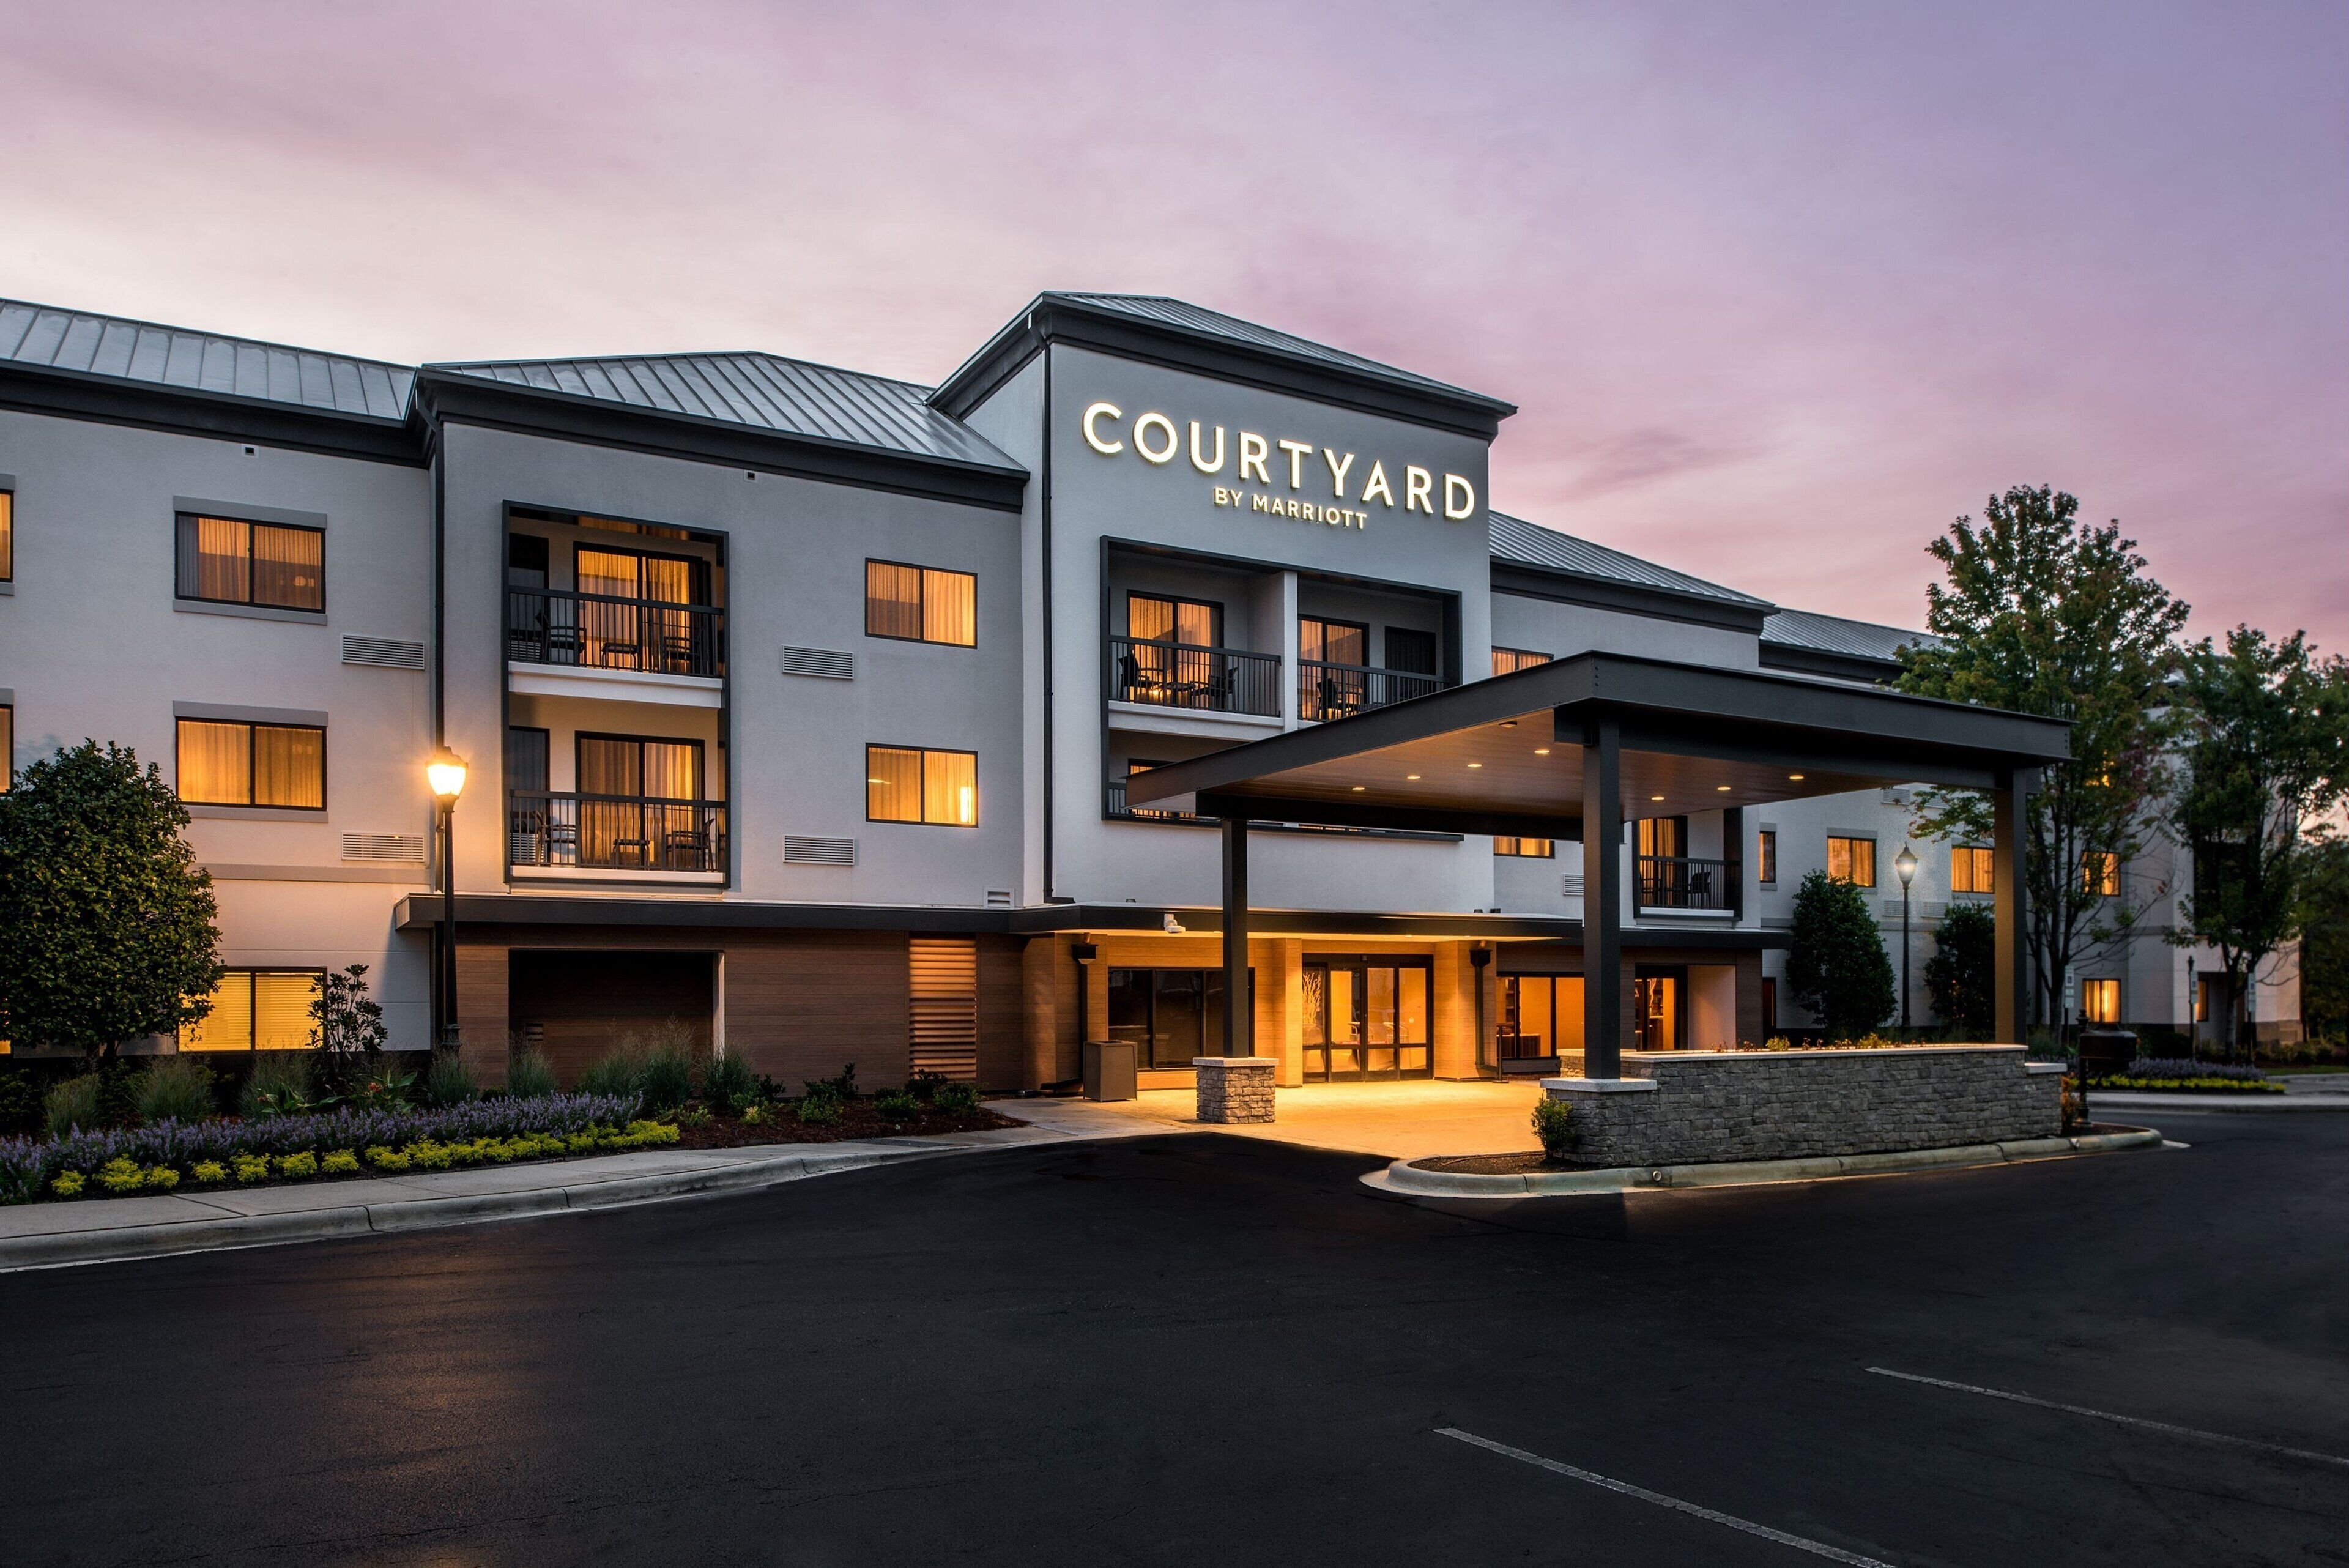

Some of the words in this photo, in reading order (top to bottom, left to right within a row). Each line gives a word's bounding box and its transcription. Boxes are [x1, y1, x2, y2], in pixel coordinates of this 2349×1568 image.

[1082, 402, 1475, 520] COURTYARD
[1214, 487, 1243, 507] BY
[1252, 493, 1368, 530] MARRIOTT
